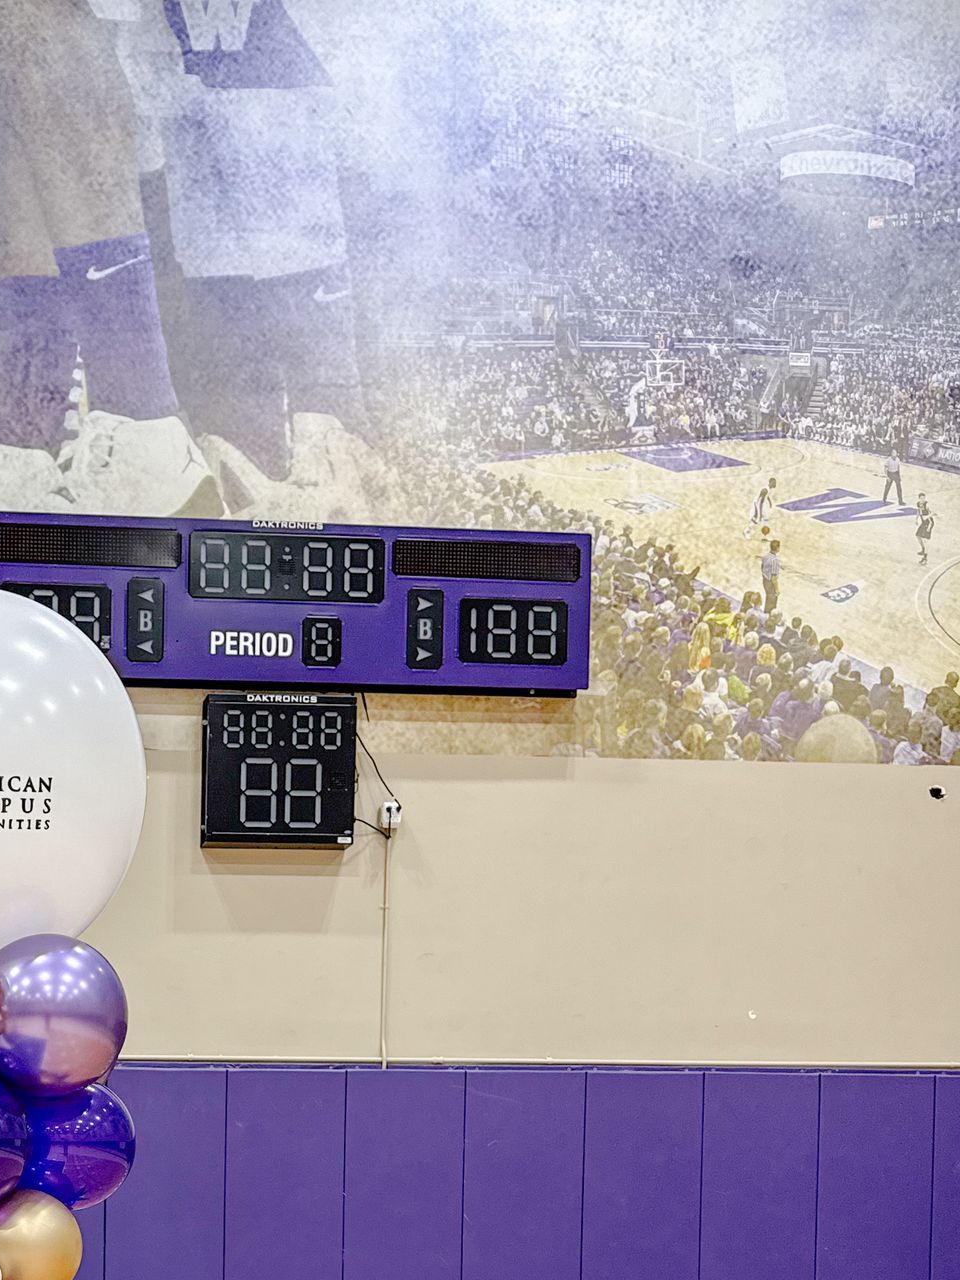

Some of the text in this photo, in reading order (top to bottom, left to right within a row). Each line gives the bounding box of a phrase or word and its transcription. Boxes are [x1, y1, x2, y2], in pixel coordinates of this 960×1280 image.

[251, 519, 325, 531] DAKTRONICS
[138, 609, 153, 632] B
[417, 617, 434, 641] B
[209, 629, 294, 658] PERIOD
[246, 694, 319, 704] DAKTRONICS
